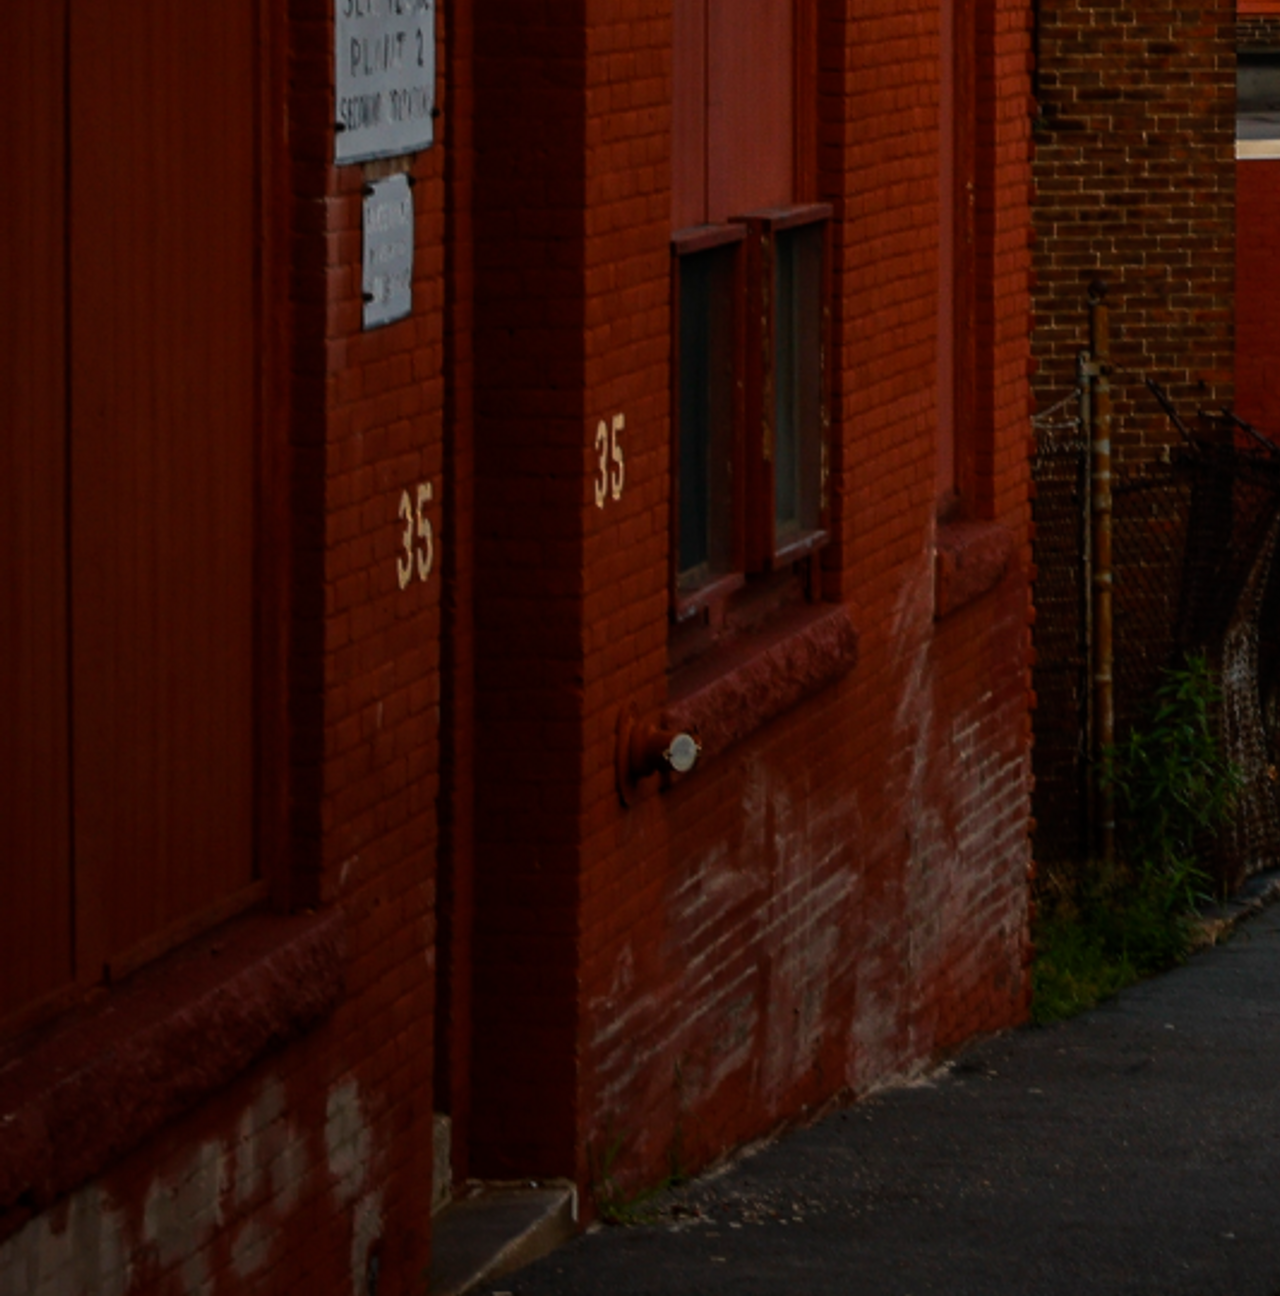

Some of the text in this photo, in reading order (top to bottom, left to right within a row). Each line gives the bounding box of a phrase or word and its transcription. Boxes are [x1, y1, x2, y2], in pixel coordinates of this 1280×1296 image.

[415, 28, 425, 68] 2
[594, 412, 626, 510] 35
[396, 481, 434, 591] 35
